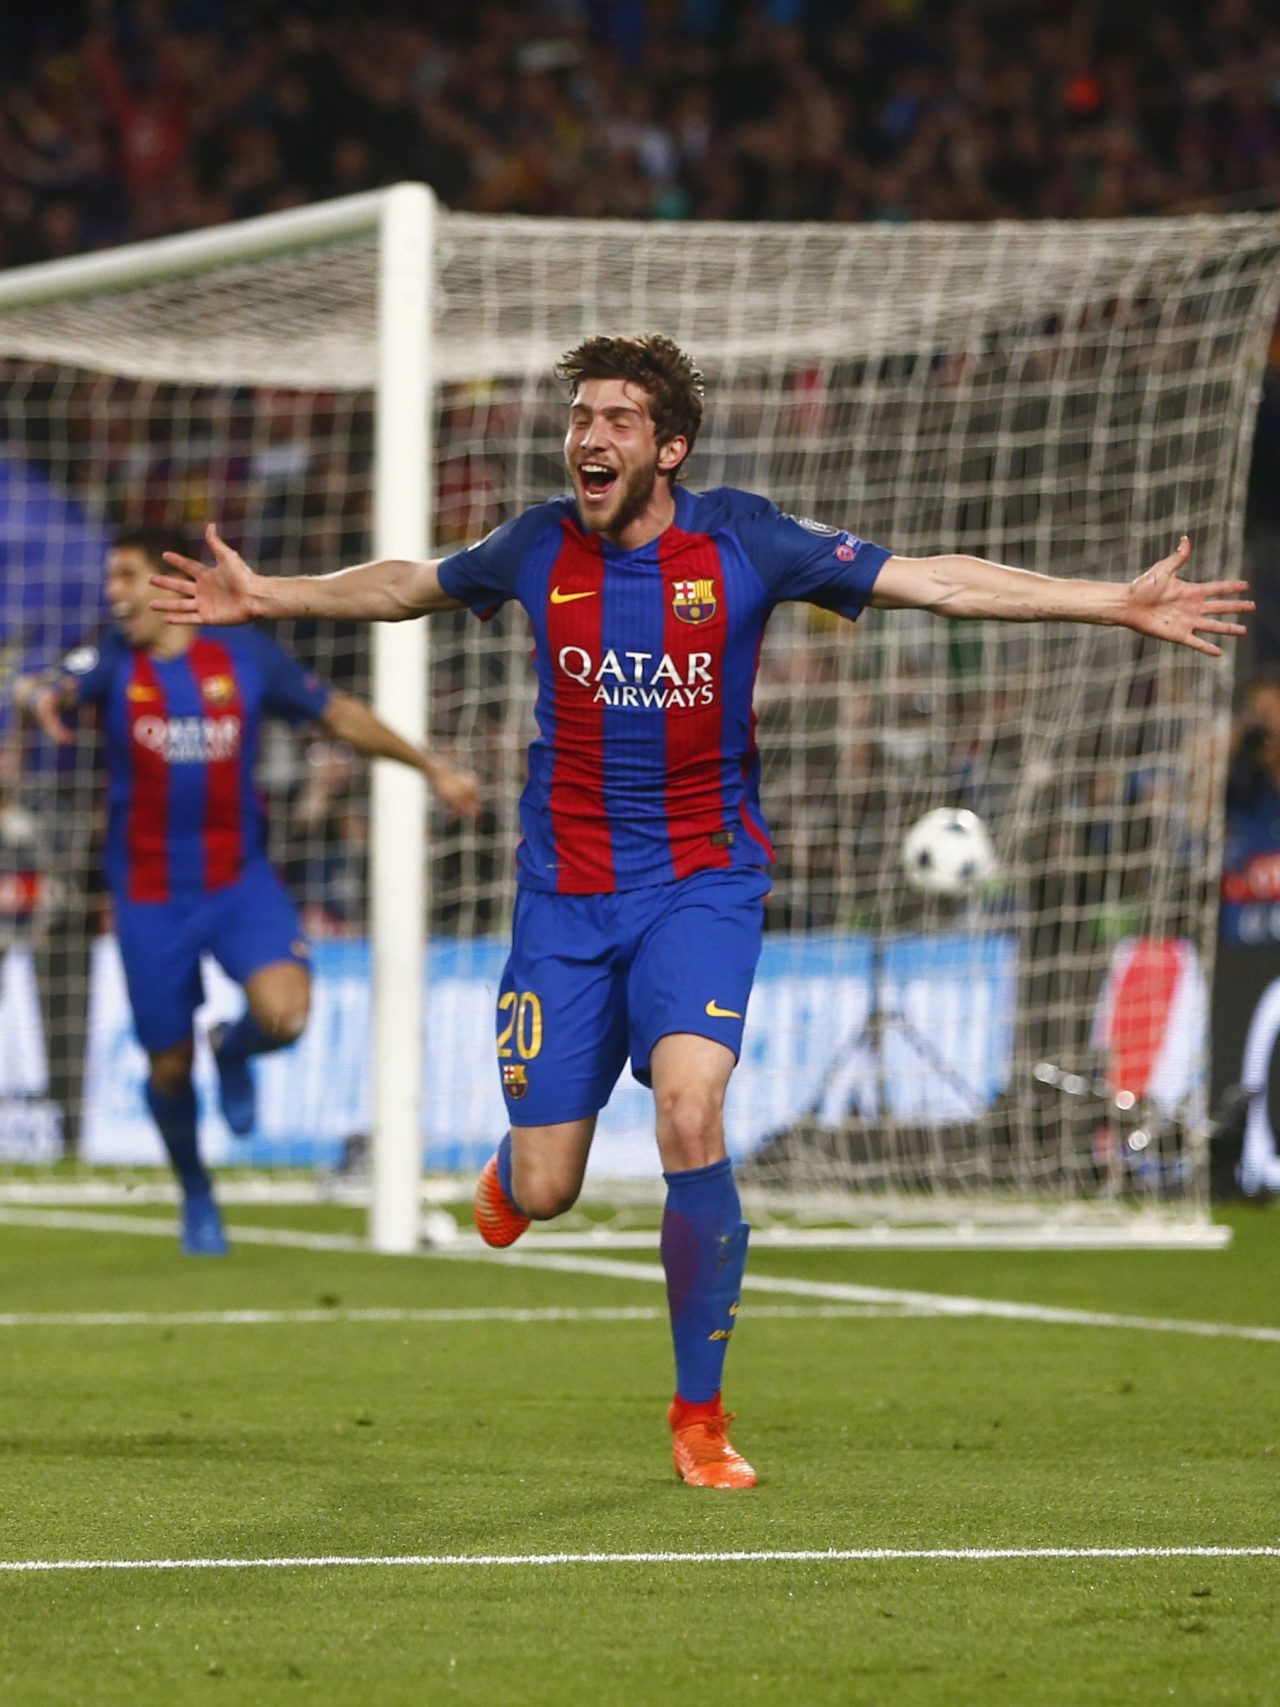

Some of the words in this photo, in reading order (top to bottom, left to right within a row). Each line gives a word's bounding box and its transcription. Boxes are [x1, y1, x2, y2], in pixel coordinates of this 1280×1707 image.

[558, 645, 713, 687] QATAR
[592, 683, 714, 708] AIRWAYS
[497, 991, 542, 1060] 20
